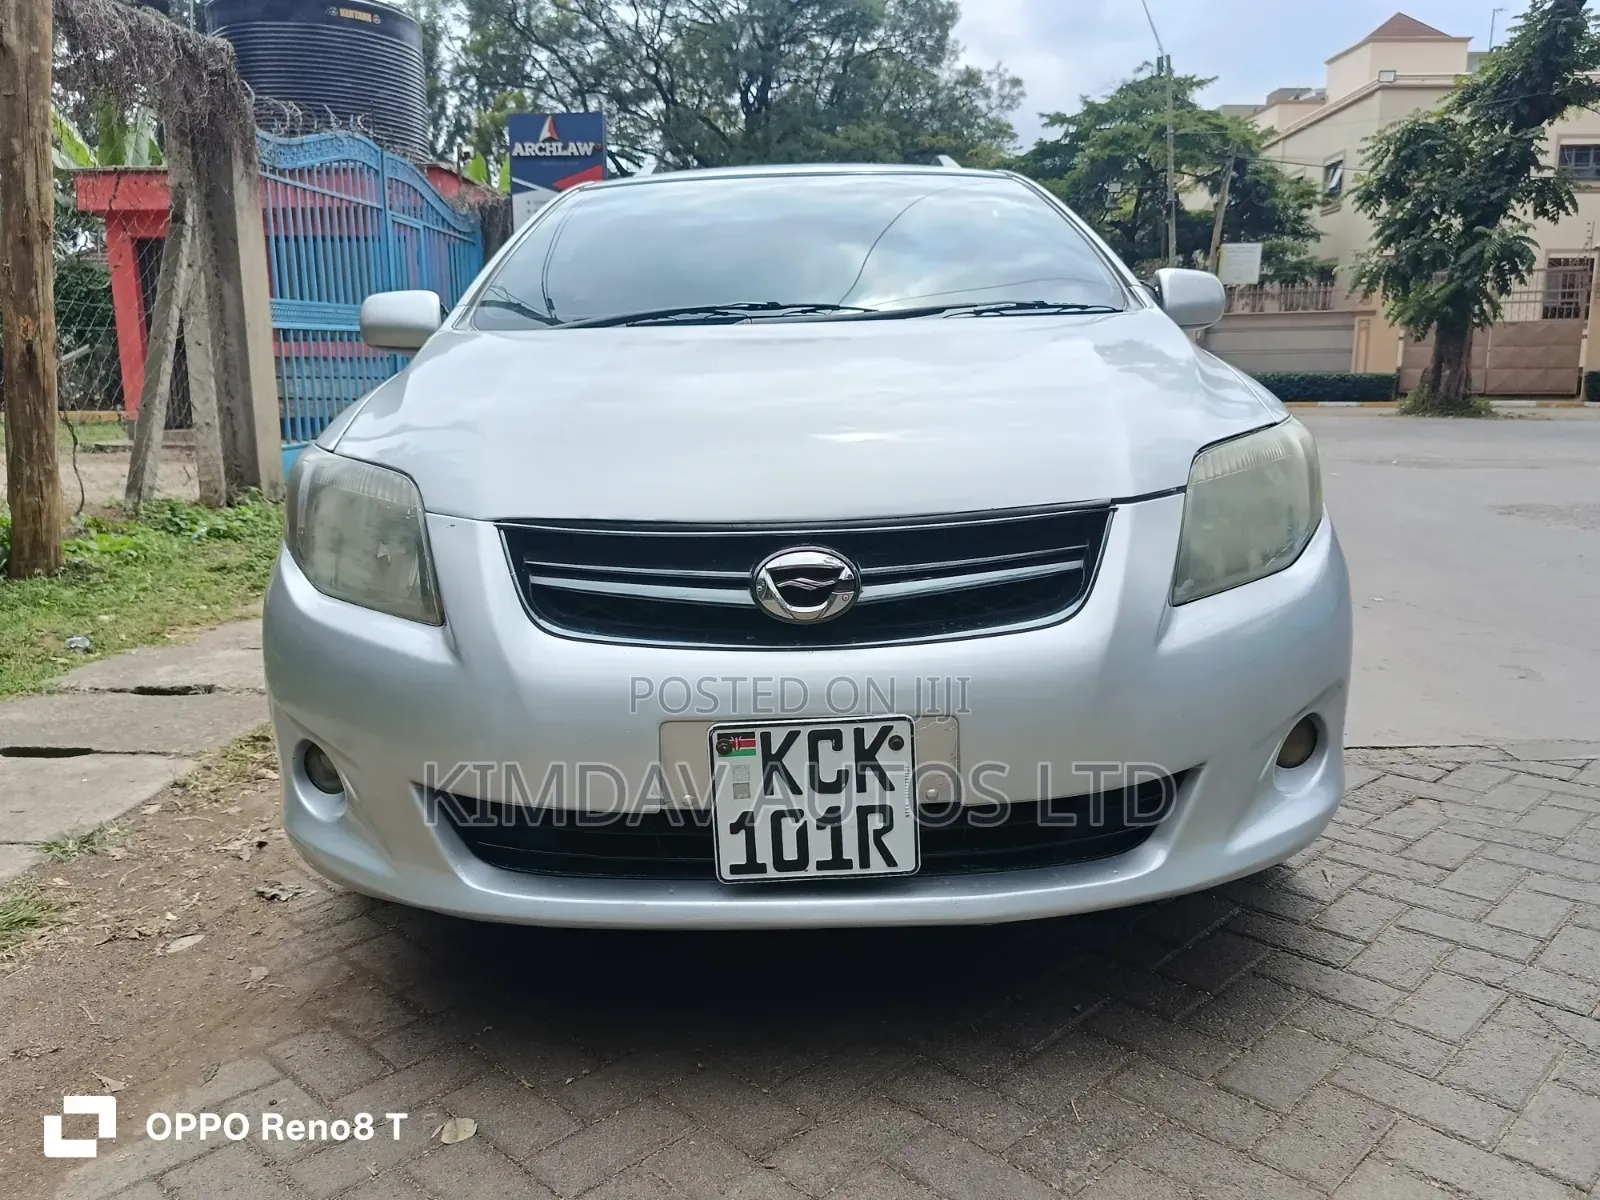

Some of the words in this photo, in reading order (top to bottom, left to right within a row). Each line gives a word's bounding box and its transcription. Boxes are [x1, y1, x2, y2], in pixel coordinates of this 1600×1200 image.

[512, 142, 595, 156] ARCHLAW
[760, 725, 895, 796] KCK
[729, 804, 898, 875] 101R
